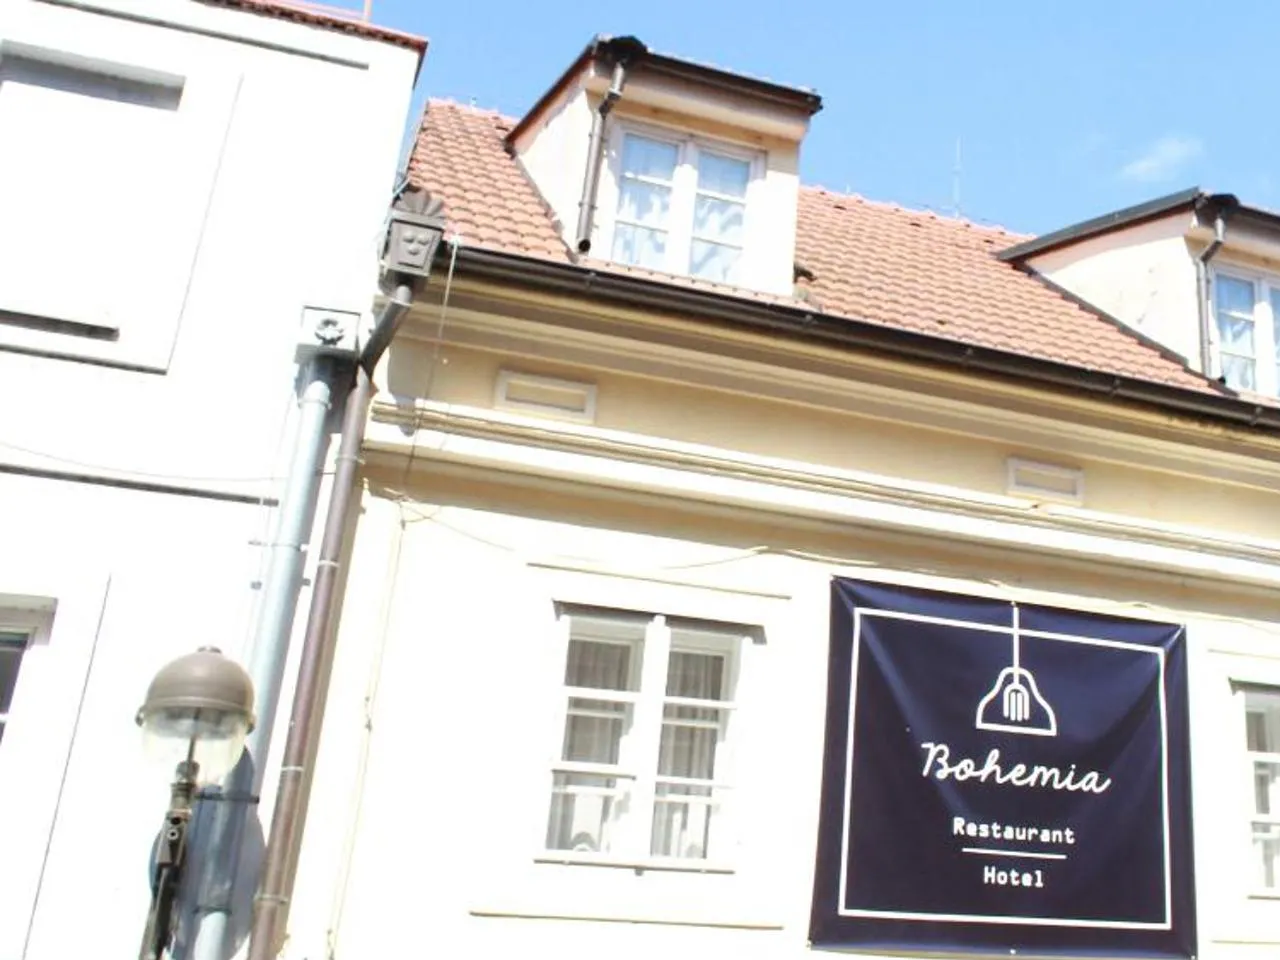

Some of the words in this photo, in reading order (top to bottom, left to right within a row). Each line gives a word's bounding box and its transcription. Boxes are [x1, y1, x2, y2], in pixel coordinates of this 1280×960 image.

[921, 742, 1112, 793] Bohemia
[953, 817, 1075, 844] Restaurant
[983, 866, 1044, 888] Hotel
